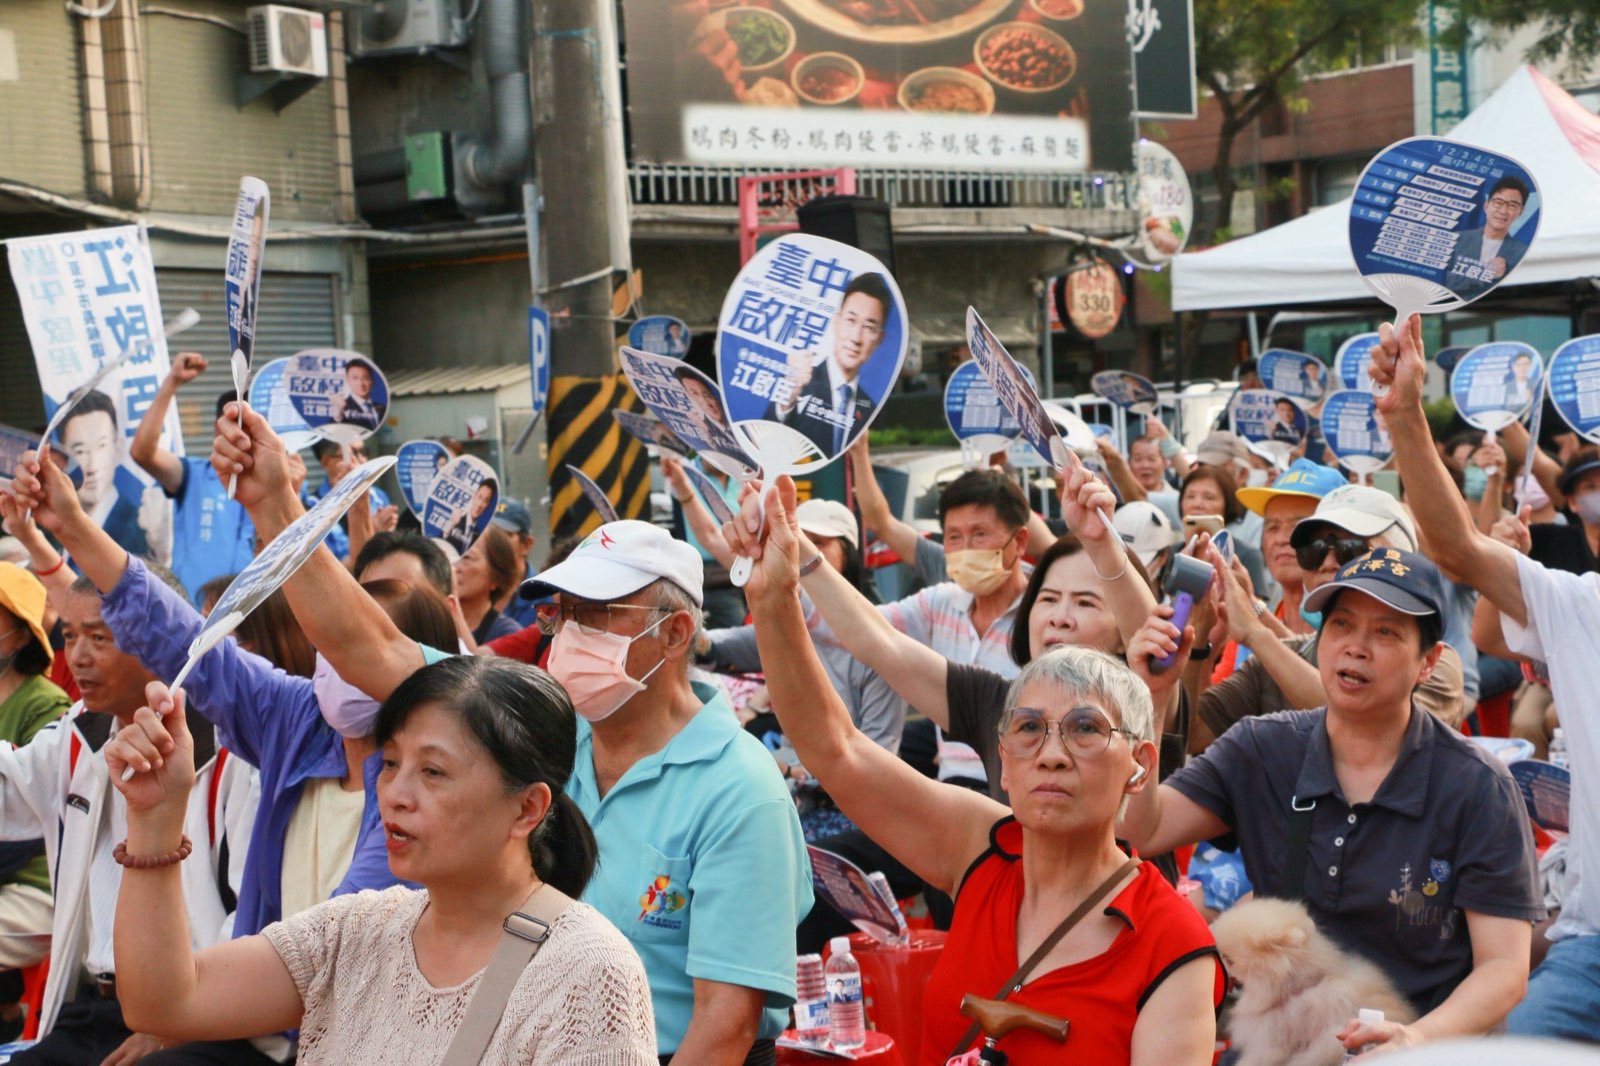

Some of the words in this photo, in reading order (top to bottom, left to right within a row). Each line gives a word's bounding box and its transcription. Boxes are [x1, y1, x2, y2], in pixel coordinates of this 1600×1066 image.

[765, 242, 854, 298] 臺中
[1452, 262, 1497, 284] 江啟臣
[728, 289, 830, 350] 啟程
[1080, 294, 1110, 312] 330
[532, 317, 547, 401] P
[730, 361, 796, 406] 江啟臣
